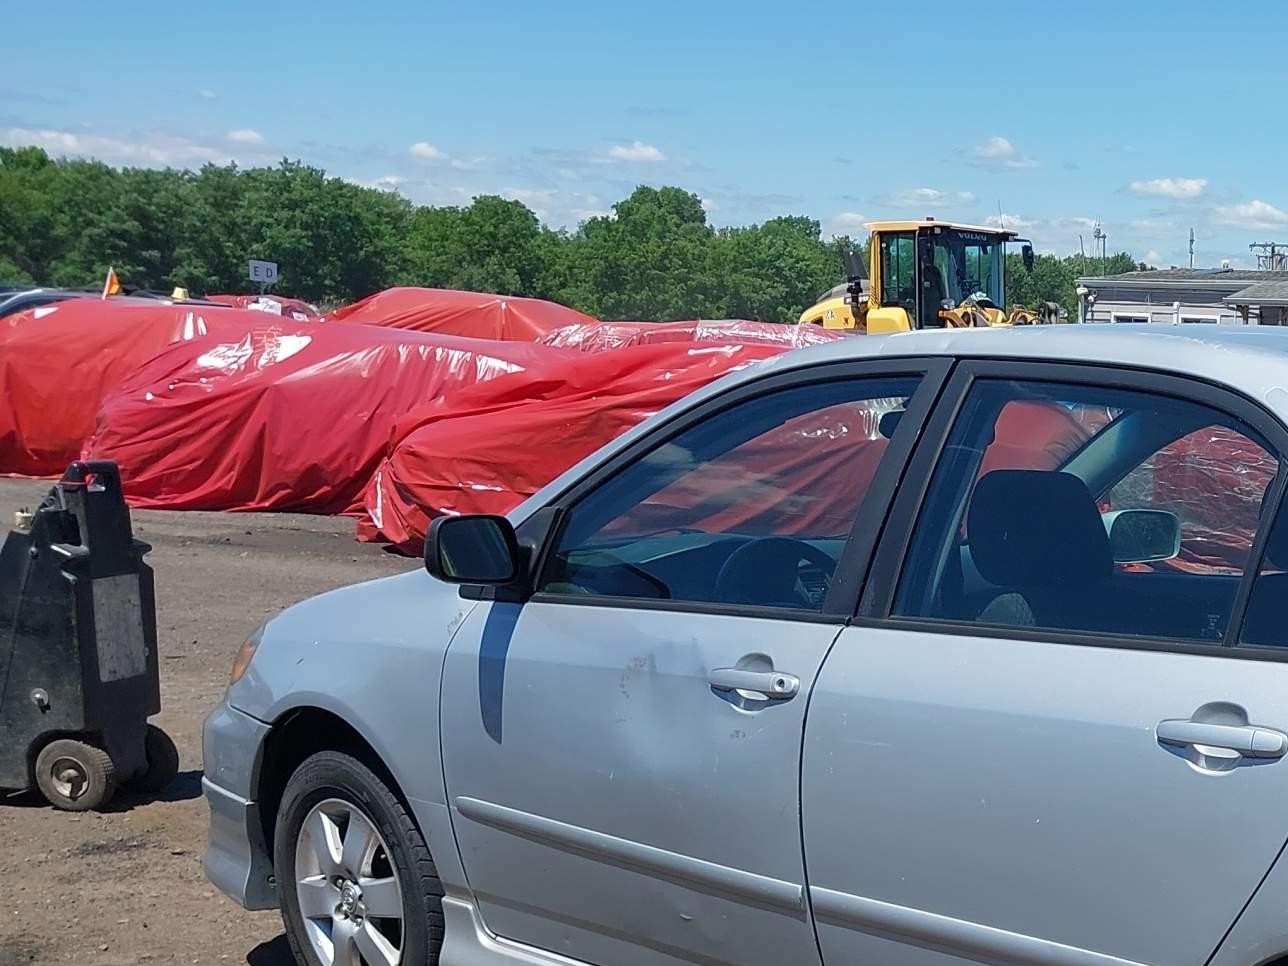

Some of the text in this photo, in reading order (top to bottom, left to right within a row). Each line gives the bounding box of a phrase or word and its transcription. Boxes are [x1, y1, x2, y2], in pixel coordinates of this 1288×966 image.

[958, 232, 988, 241] VOLVO
[253, 265, 273, 279] E D
